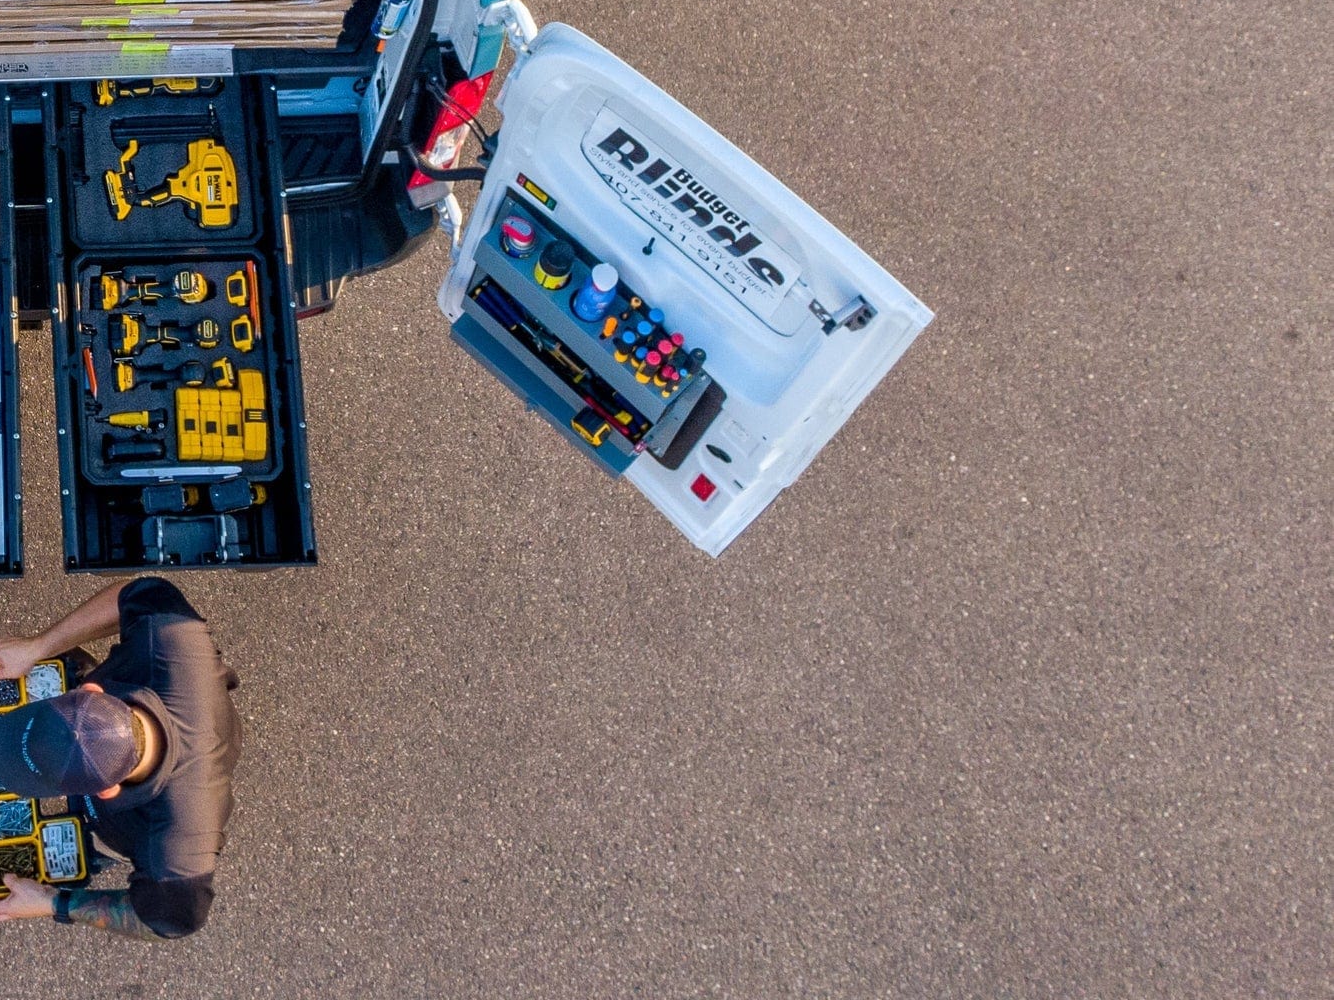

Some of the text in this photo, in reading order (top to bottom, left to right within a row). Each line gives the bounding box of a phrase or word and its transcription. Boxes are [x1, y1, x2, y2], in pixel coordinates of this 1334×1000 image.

[588, 146, 617, 170] Style
[617, 168, 640, 188] and
[640, 187, 678, 222] service
[679, 219, 696, 235] for
[696, 233, 726, 260] every
[597, 127, 785, 288] Blinds
[601, 173, 748, 294] 407-841-9151
[672, 167, 751, 233] Budget
